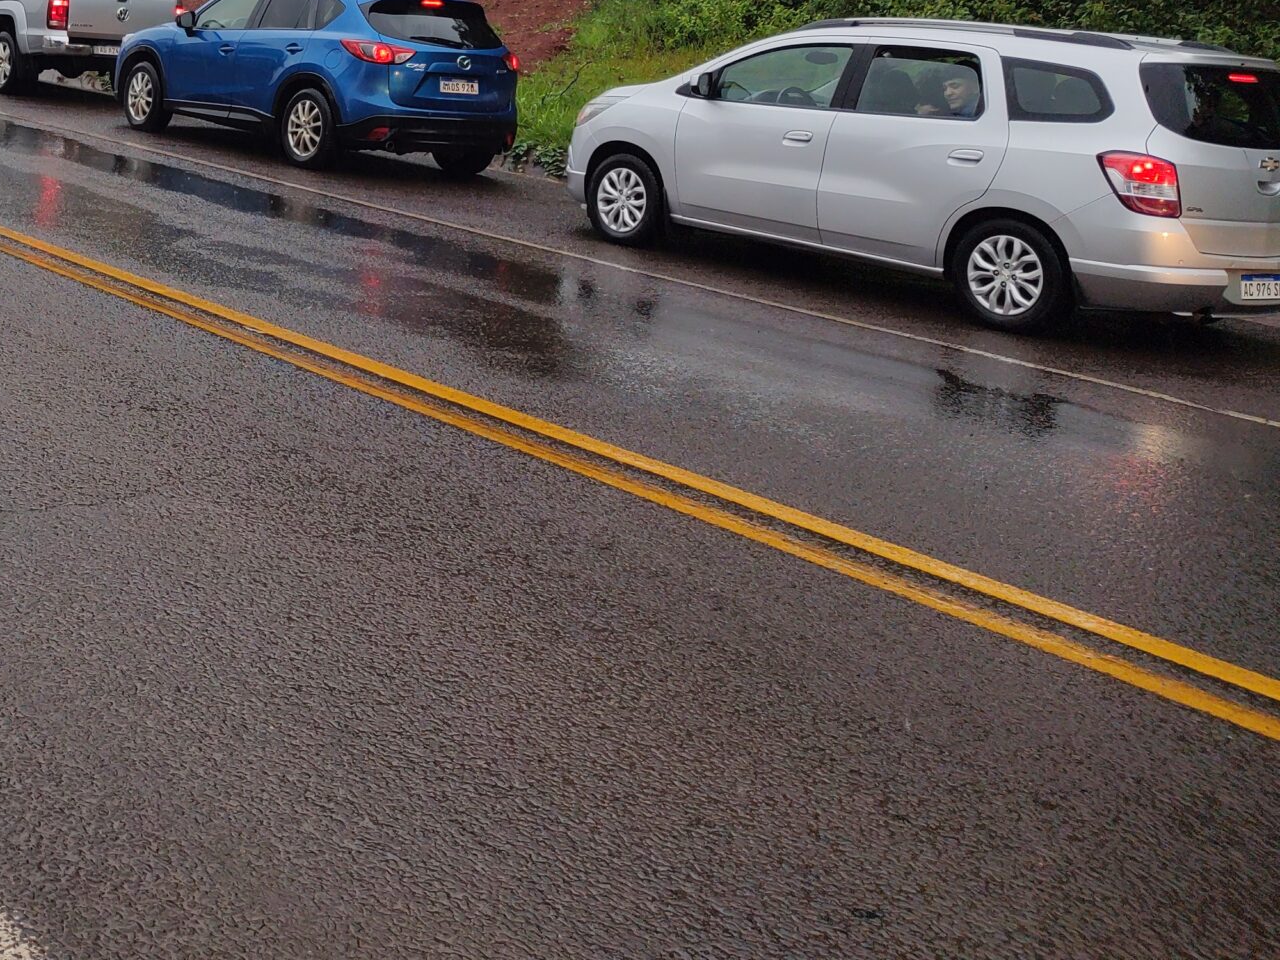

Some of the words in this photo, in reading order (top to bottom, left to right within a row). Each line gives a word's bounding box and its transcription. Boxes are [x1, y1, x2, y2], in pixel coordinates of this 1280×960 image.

[1244, 282, 1254, 297] AC
[1256, 282, 1272, 297] 976
[1273, 282, 1280, 297] S
